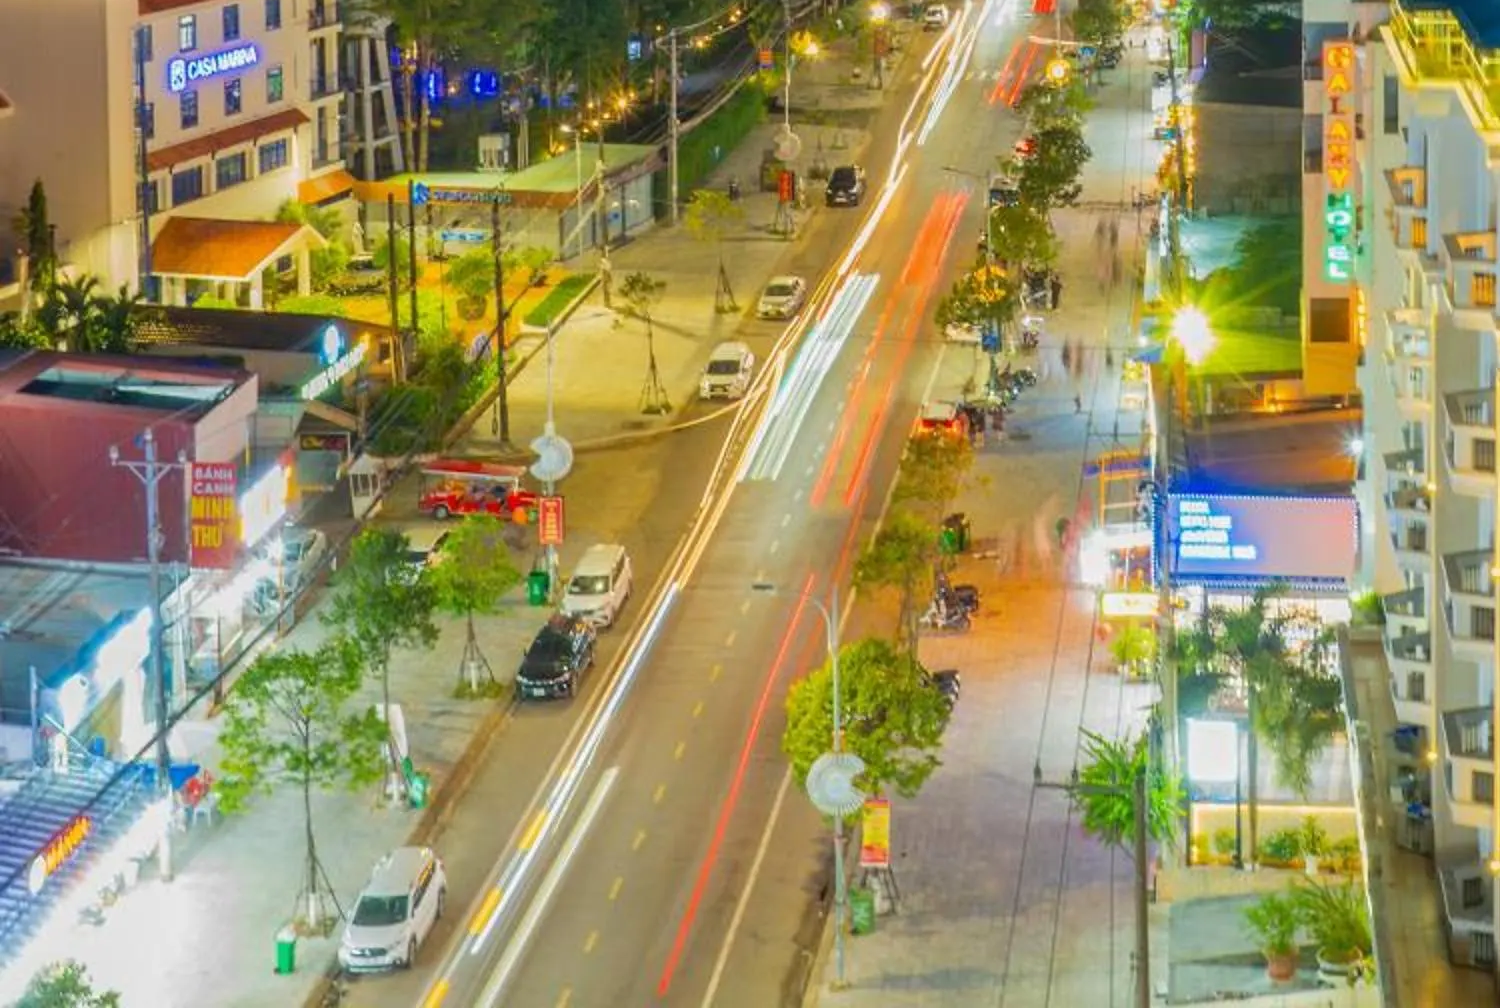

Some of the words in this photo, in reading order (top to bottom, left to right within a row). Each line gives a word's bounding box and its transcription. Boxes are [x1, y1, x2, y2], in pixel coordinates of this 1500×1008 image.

[187, 55, 218, 81] CASA
[1327, 47, 1351, 189] GALAXY
[1327, 193, 1351, 279] HOTEL
